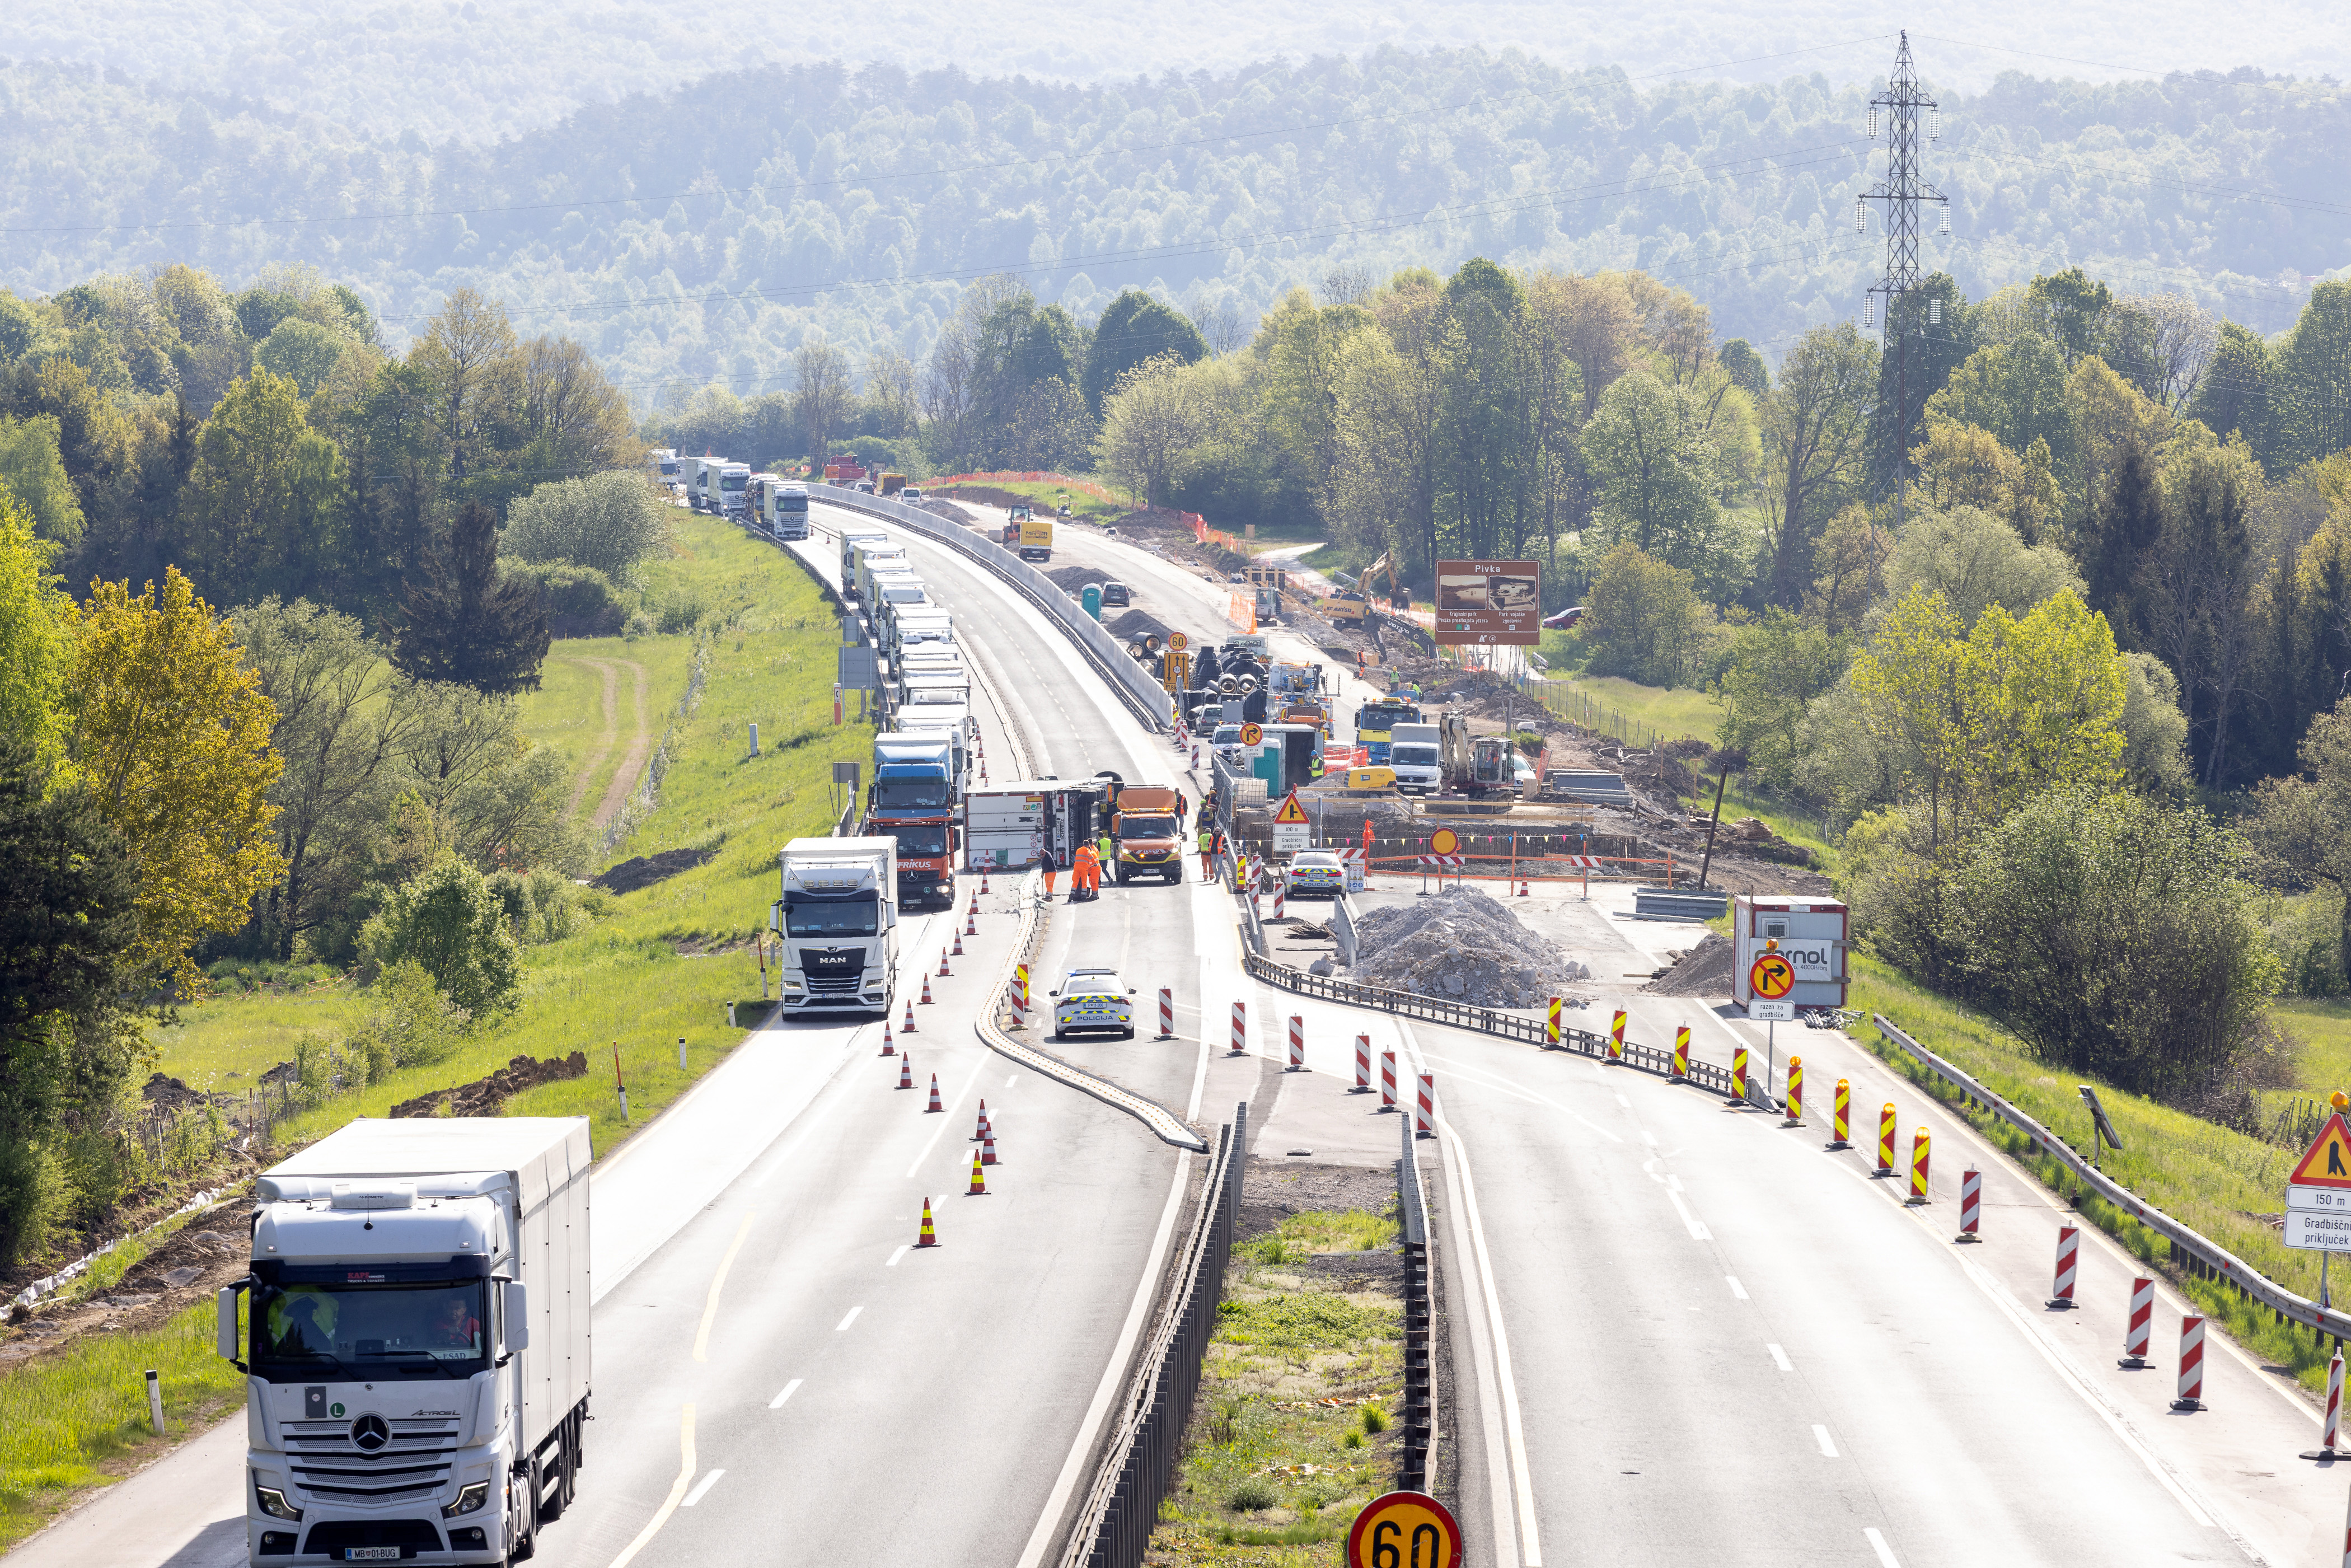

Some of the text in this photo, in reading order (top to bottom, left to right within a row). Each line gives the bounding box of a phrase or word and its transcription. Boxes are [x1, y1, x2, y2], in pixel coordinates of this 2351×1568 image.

[1475, 564, 1501, 573] Pivka
[1387, 621, 1410, 634] VOLVO
[1172, 636, 1184, 647] 60
[2316, 1194, 2331, 1205] 150
[2305, 1233, 2349, 1246] priključek
[334, 1405, 341, 1415] L
[1372, 1520, 1440, 1568] 60
[354, 1548, 396, 1558] MB 01-BUG
